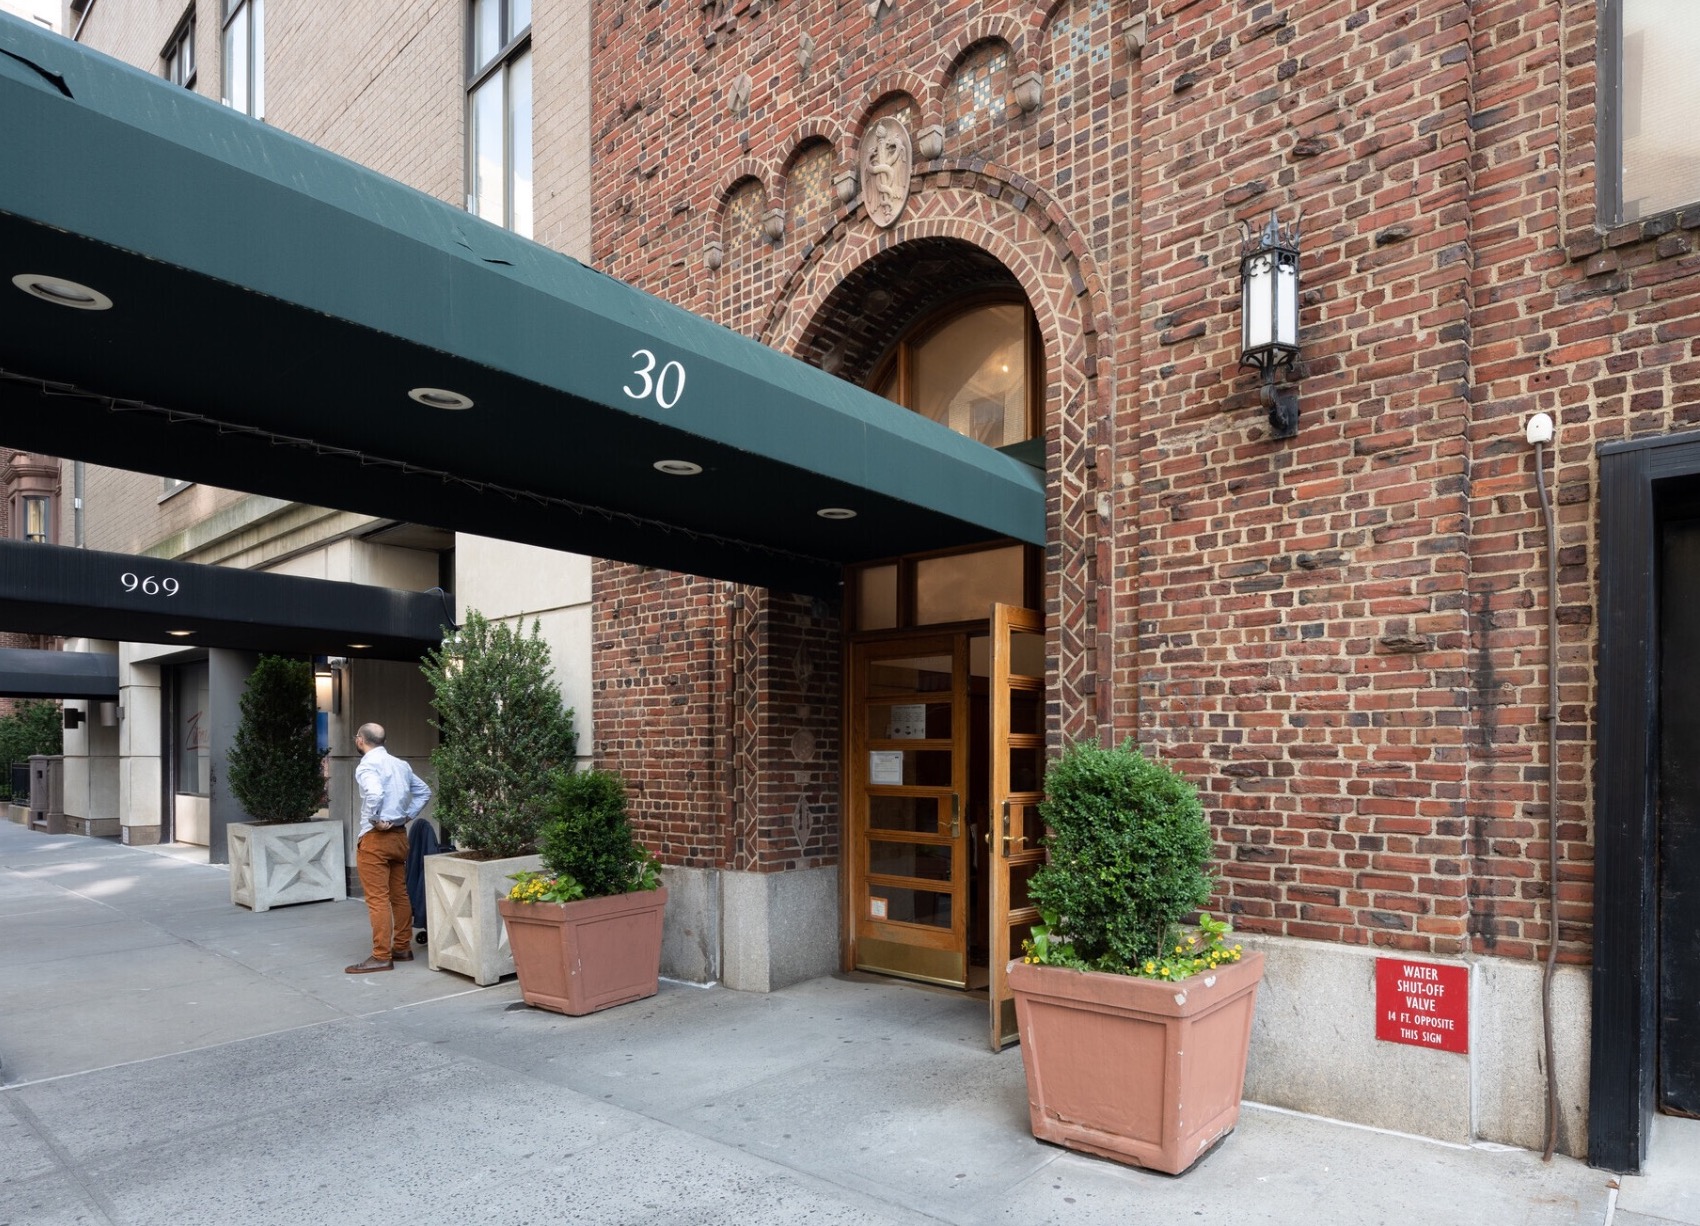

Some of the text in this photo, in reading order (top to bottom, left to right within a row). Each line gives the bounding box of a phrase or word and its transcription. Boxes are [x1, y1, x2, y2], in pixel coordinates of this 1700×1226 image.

[623, 349, 686, 409] 30
[121, 572, 179, 597] 969
[1403, 965, 1438, 980] WATER
[1397, 979, 1445, 997] SHUT-OFF
[1406, 996, 1436, 1012] VALVE
[1388, 1010, 1454, 1031] 14 FT. OPPOSITE
[1400, 1028, 1442, 1044] THIS SIGN
